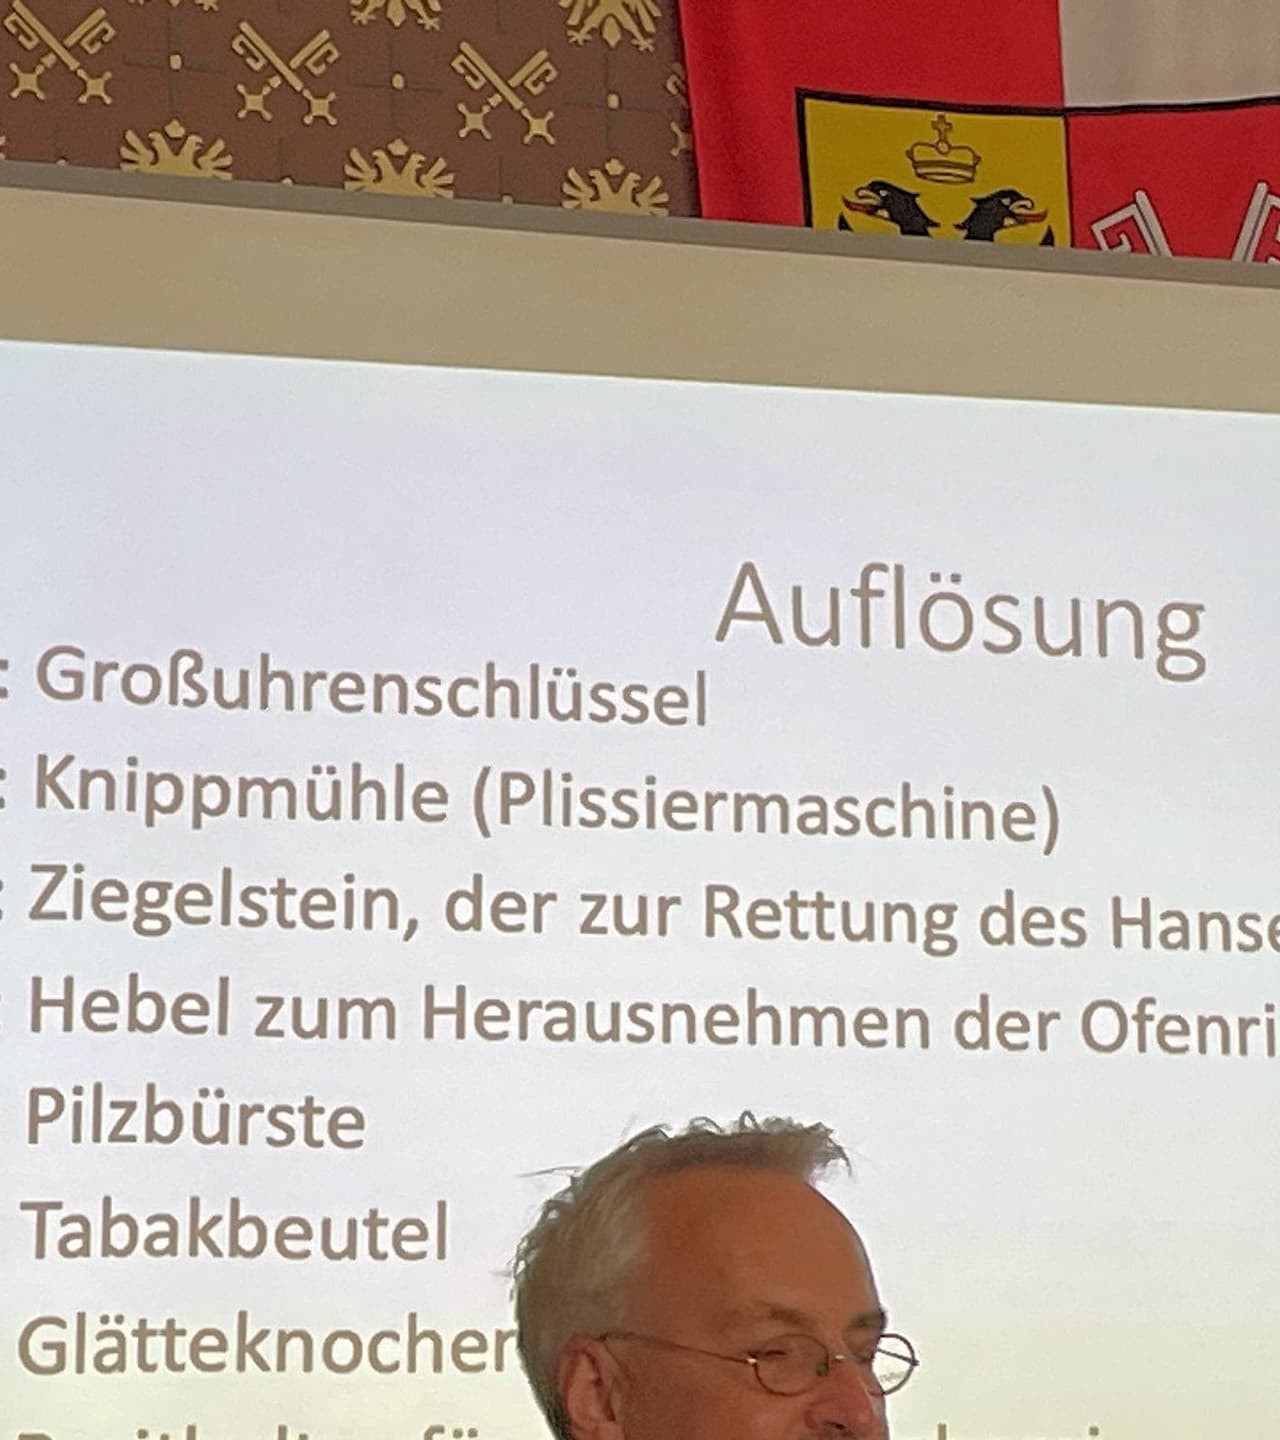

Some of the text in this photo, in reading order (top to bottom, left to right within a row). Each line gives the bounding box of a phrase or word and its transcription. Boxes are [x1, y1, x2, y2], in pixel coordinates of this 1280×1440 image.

[715, 562, 1206, 682] Auflösung
[37, 645, 706, 726] Großuhrenschlüssel
[36, 754, 449, 830] Knippmühle
[474, 766, 1059, 856] (Plissiermaschine)
[29, 863, 418, 942] Ziegelstein,
[445, 873, 558, 934] der
[580, 893, 682, 937] zur
[705, 884, 958, 957] Rettung
[980, 888, 1087, 948] des
[31, 972, 229, 1036] Hebel
[254, 996, 396, 1040] zum
[424, 984, 930, 1049] Herausnehmen
[954, 993, 1061, 1051] der
[28, 1082, 365, 1149] Pilzbürste
[19, 1195, 446, 1261] Tabakbeutel
